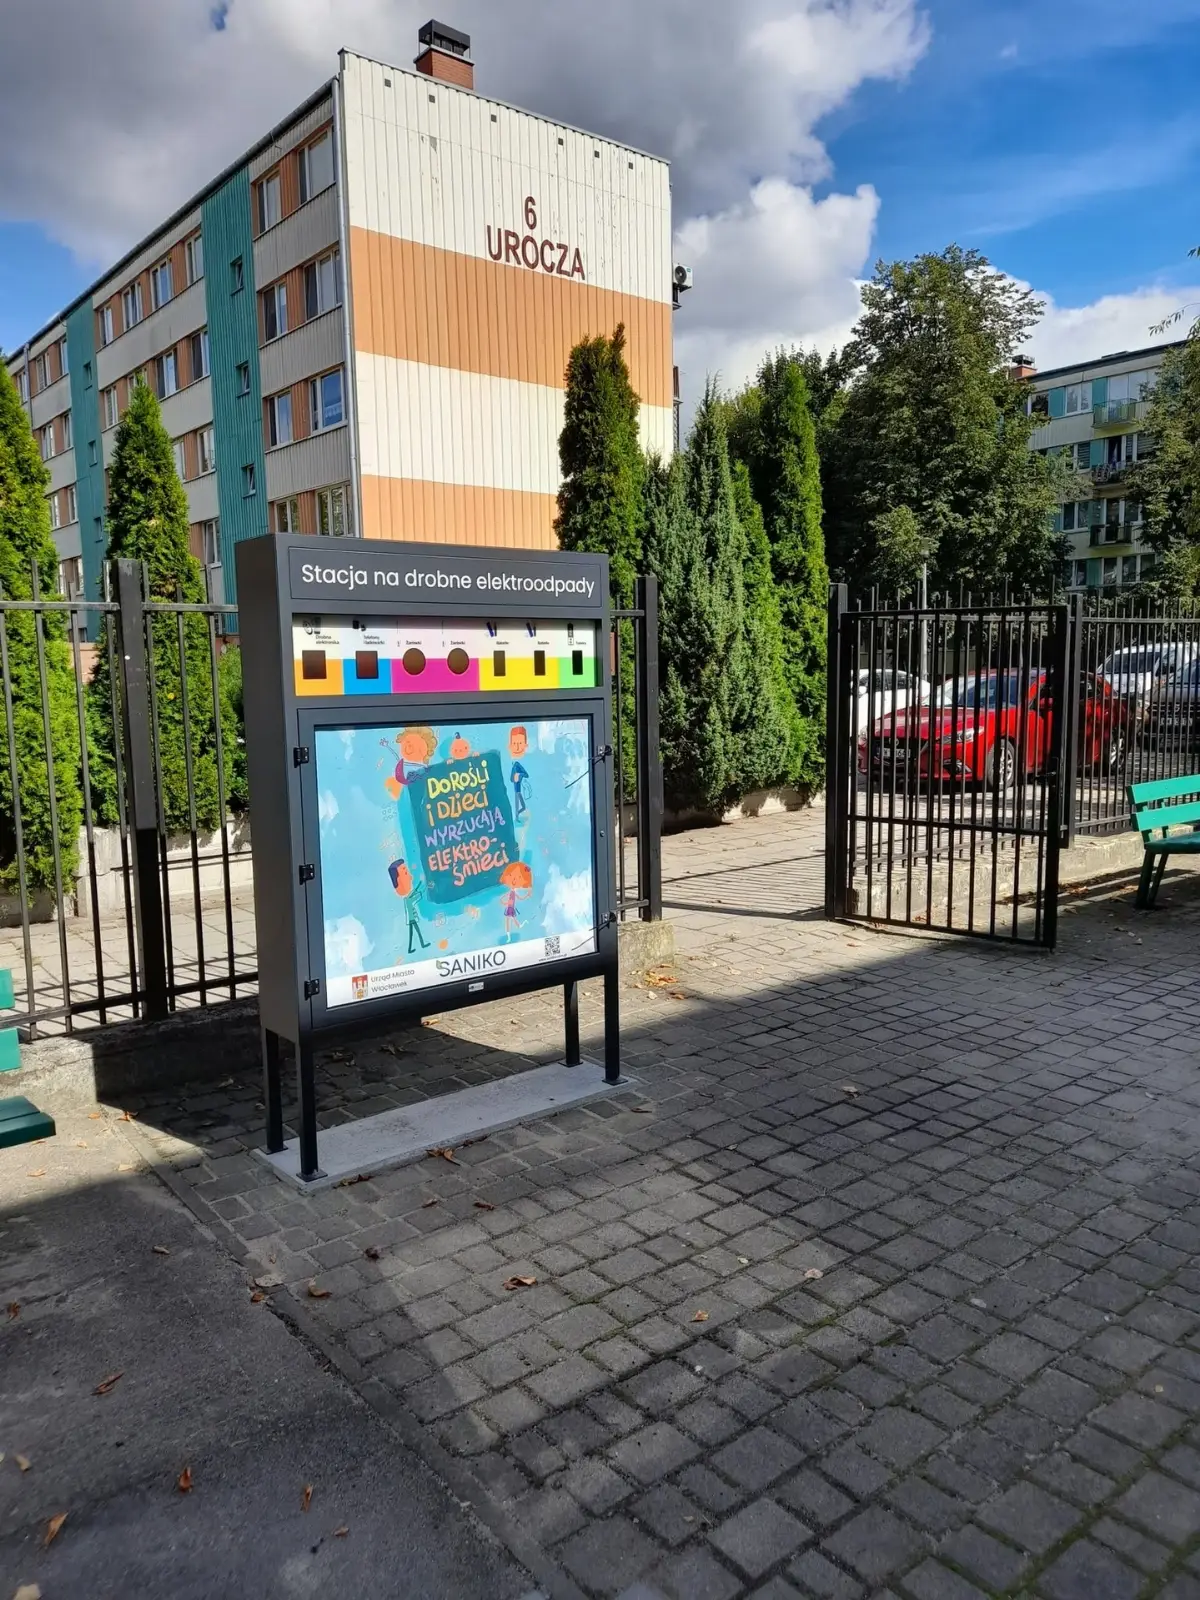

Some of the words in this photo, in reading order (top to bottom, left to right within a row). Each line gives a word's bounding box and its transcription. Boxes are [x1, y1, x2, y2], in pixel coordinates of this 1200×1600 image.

[524, 195, 538, 231] 6
[486, 224, 586, 281] UROCZA
[301, 564, 368, 590] Stacja
[373, 570, 399, 586] na
[404, 569, 472, 589] drobne
[476, 573, 595, 598] elektroodpady
[424, 806, 506, 848] WYRZUCAJĄ
[426, 803, 435, 827] i
[370, 973, 392, 983] Urząd
[392, 969, 415, 978] Miasta
[439, 949, 507, 977] SANIKO
[371, 980, 408, 993] Włocławek
